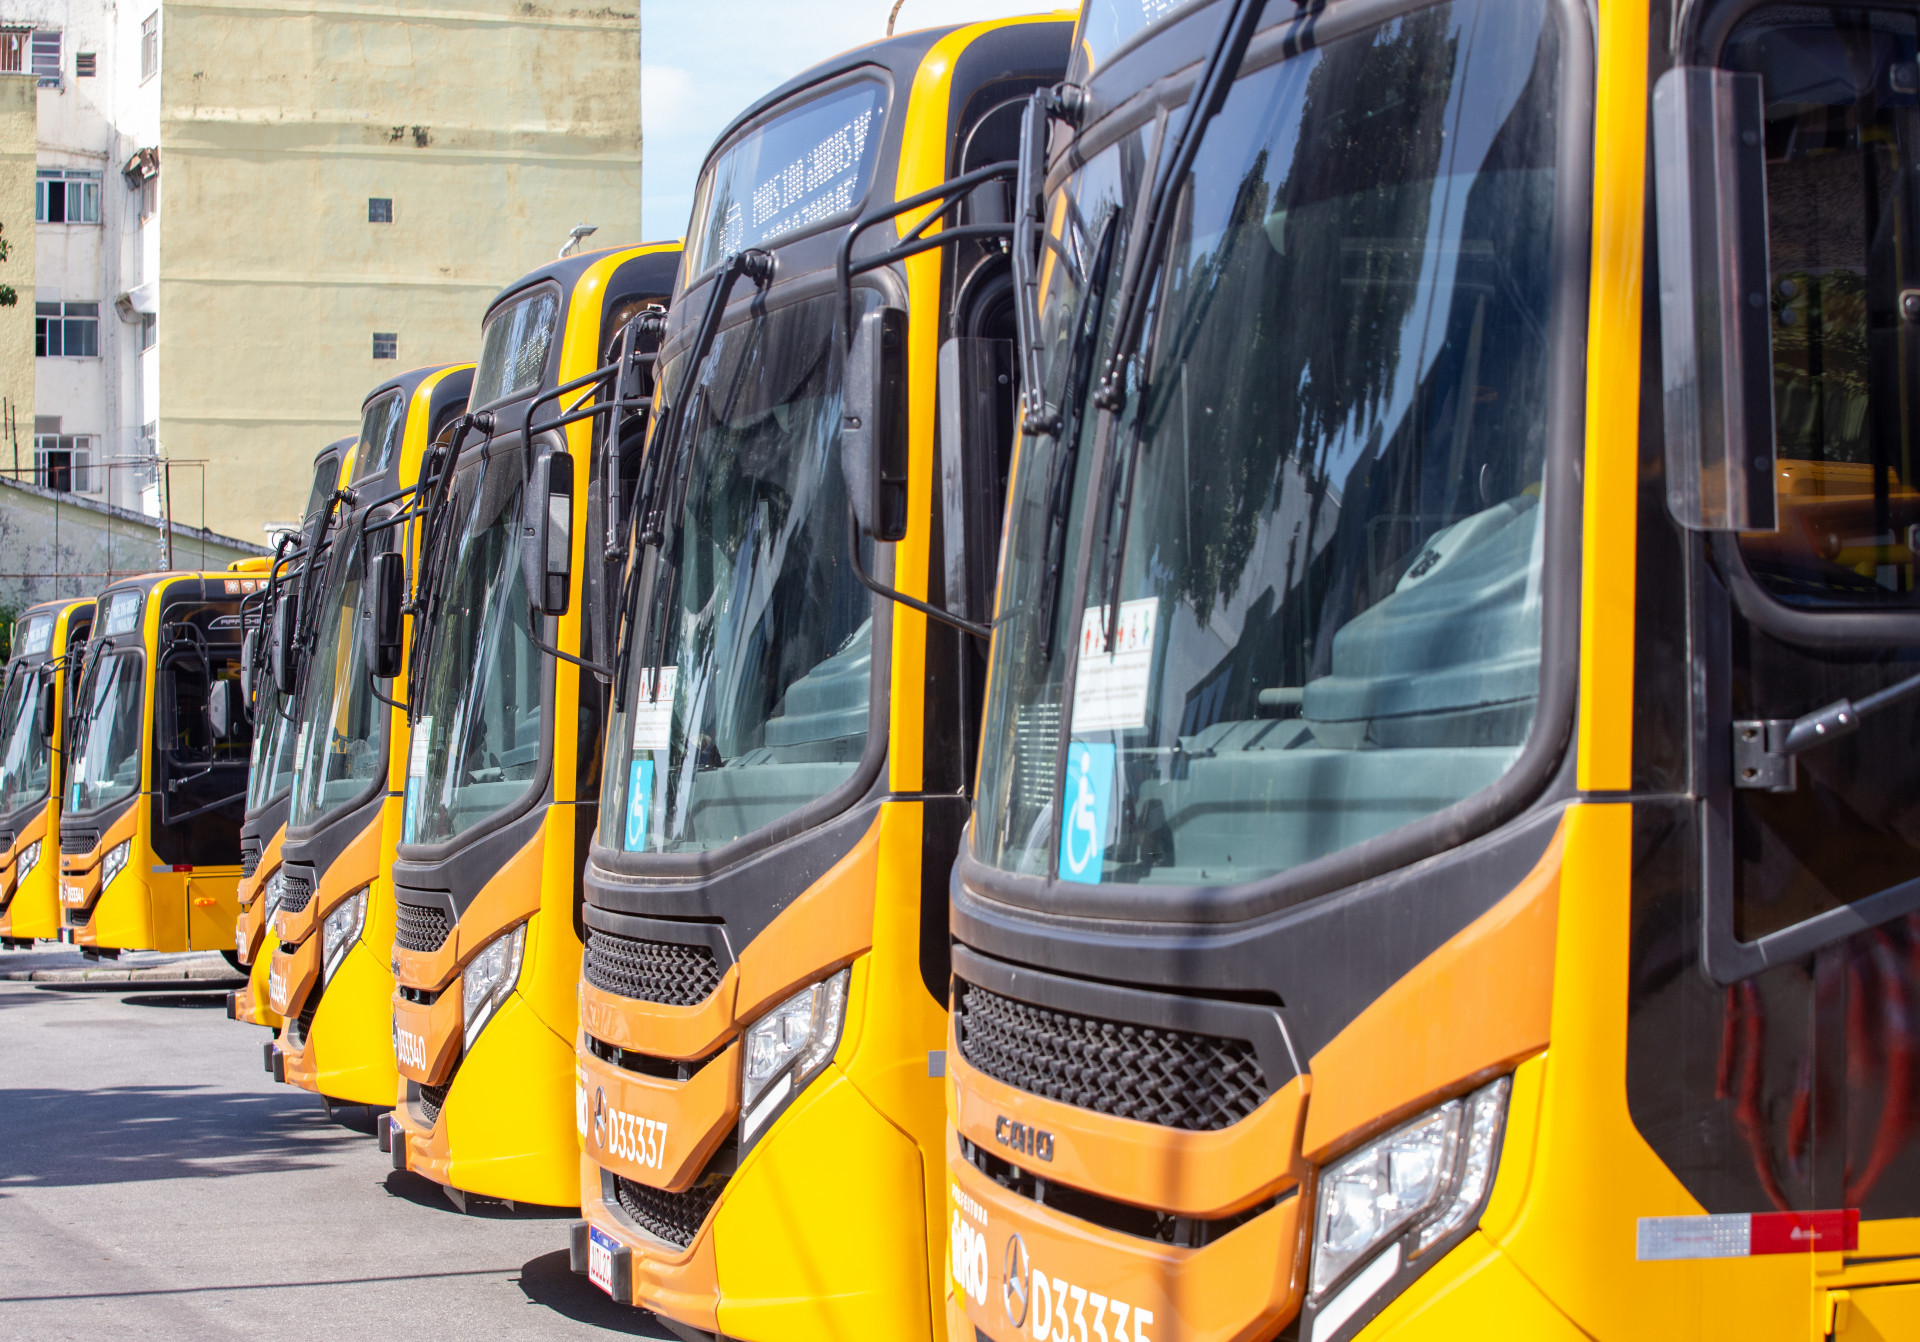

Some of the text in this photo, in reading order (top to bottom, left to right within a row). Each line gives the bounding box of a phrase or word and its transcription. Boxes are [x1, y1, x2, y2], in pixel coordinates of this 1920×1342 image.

[608, 1107, 668, 1170] D33337
[995, 1115, 1055, 1162] CAIO
[952, 1182, 988, 1226] PREFEITURA
[961, 1219, 989, 1306] RIO
